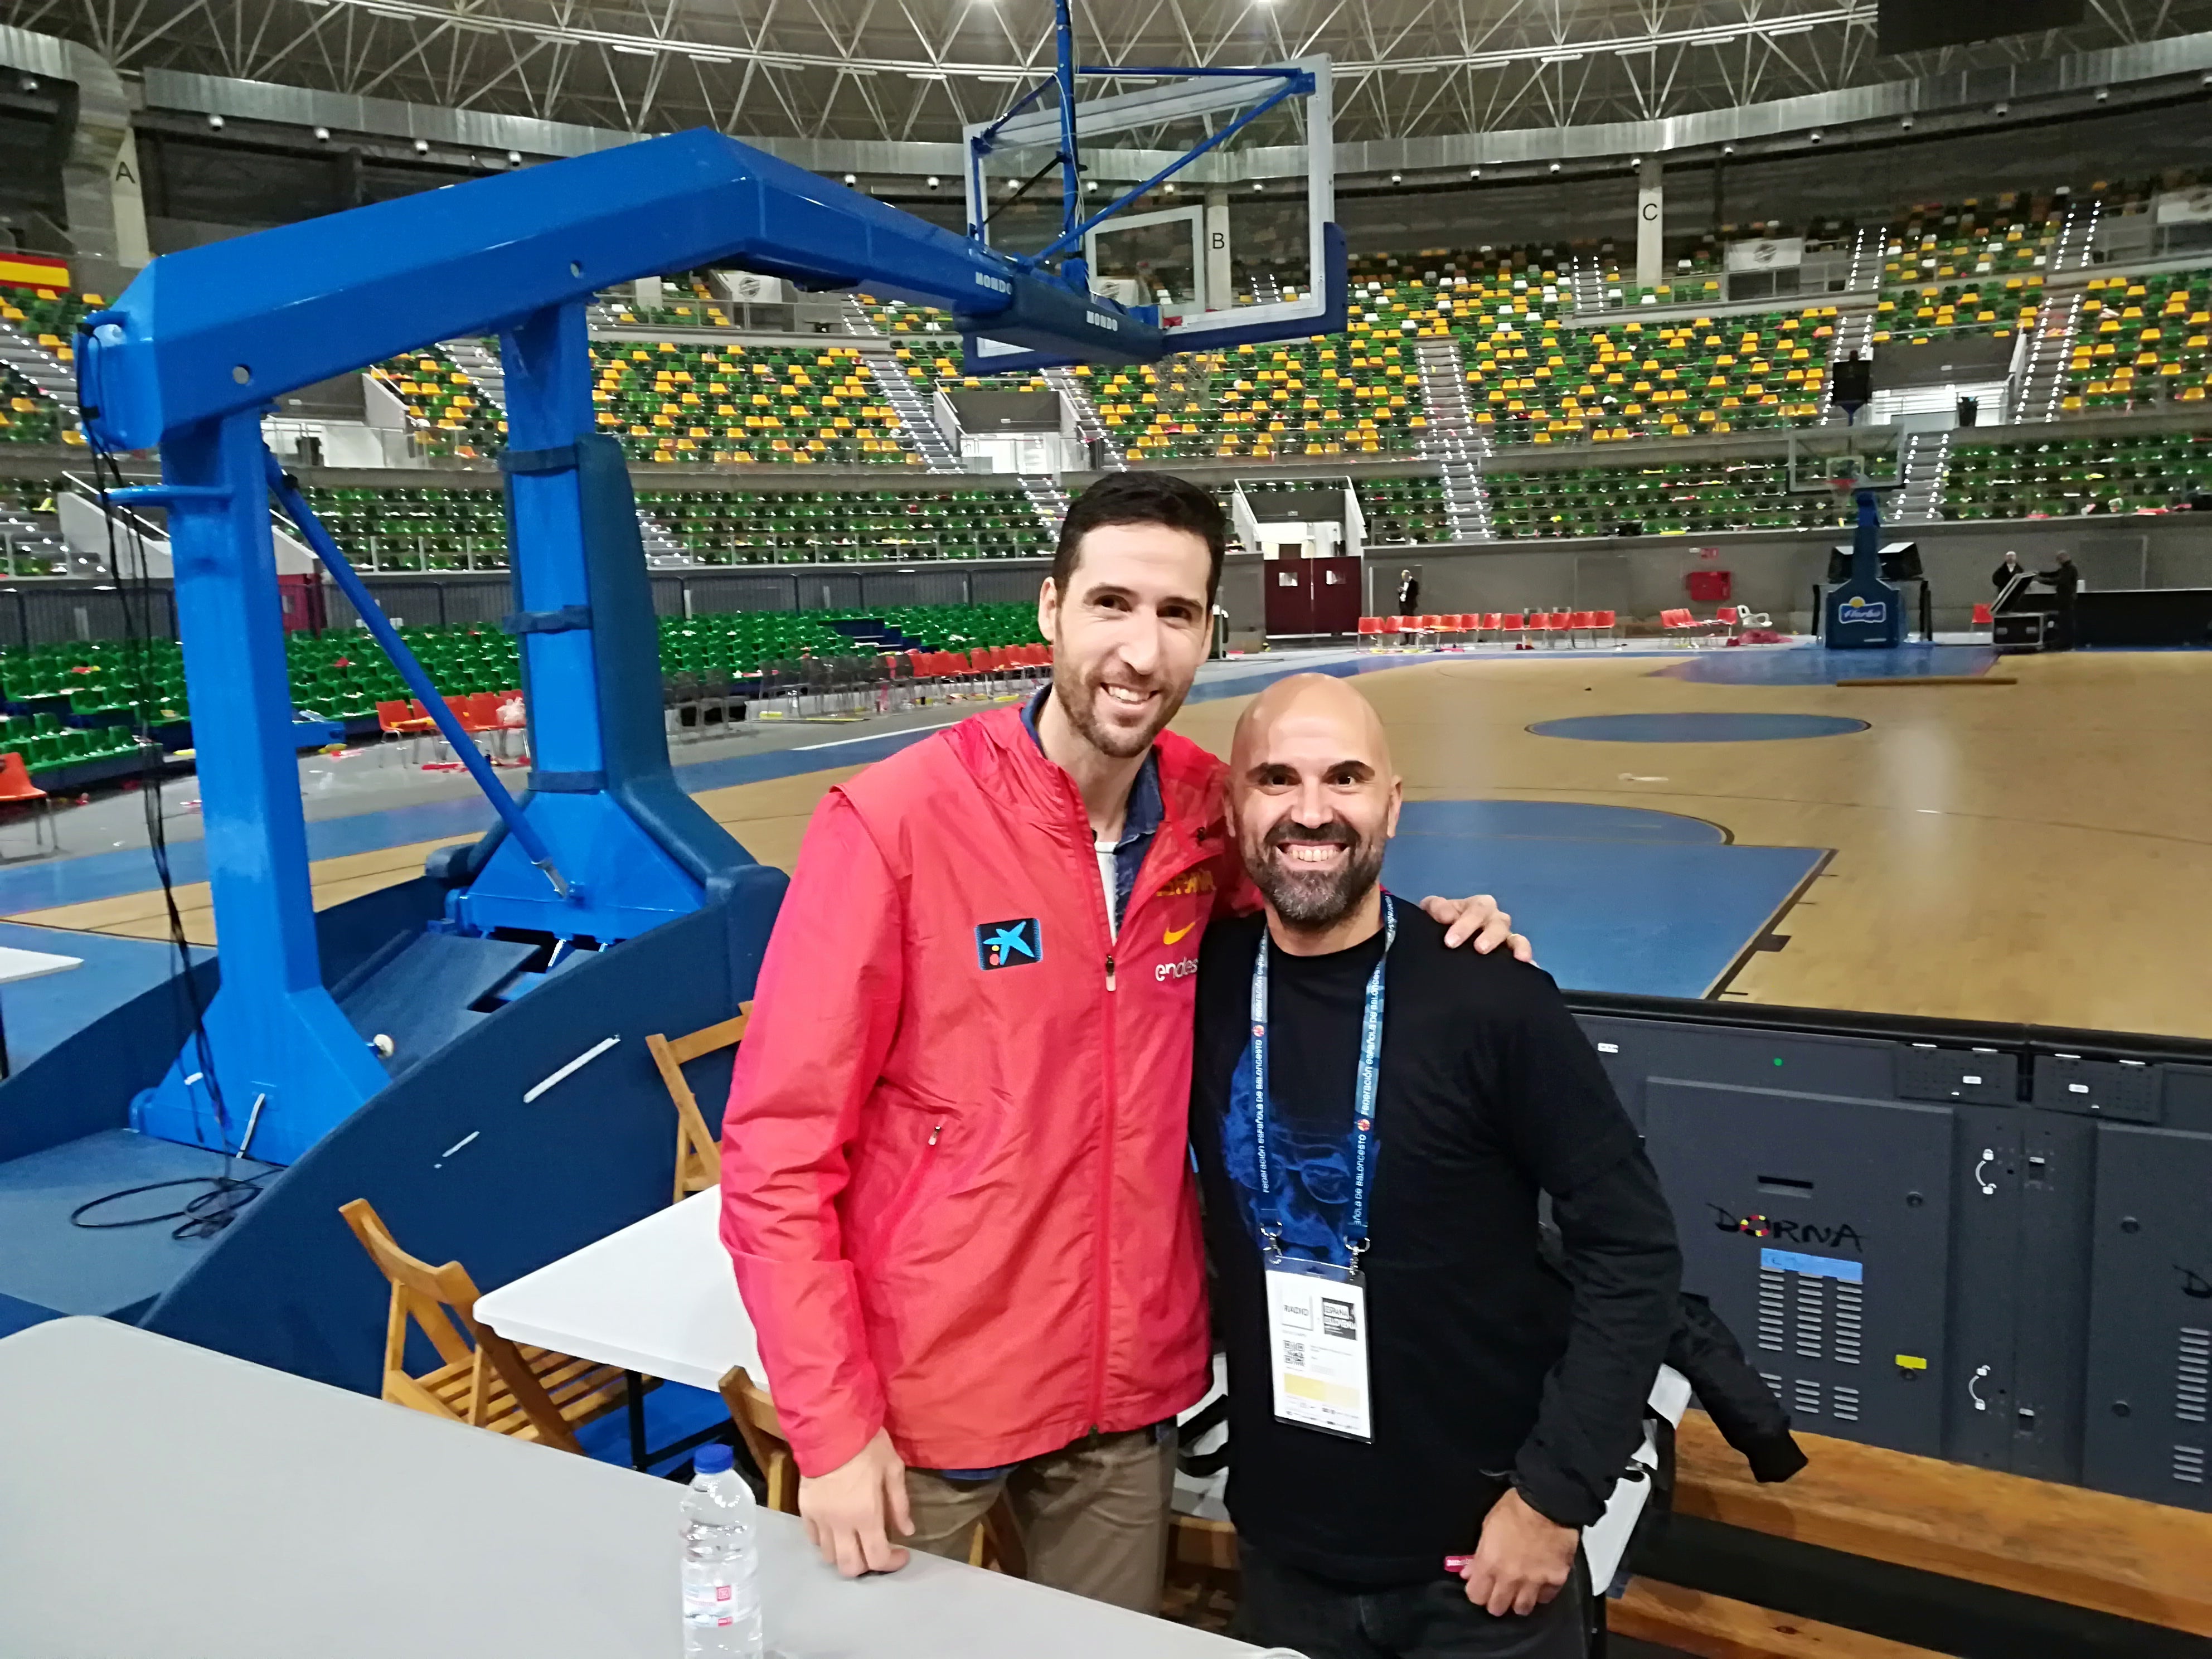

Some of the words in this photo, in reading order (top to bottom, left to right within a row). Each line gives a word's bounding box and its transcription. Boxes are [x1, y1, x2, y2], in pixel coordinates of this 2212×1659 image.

[115, 161, 135, 183] A
[1643, 203, 1657, 221] C
[1212, 232, 1225, 249] B
[976, 271, 1012, 295] MONDO
[1086, 311, 1118, 331] MONDO
[1155, 956, 1199, 982] endes
[1706, 1202, 1864, 1253] DORNA
